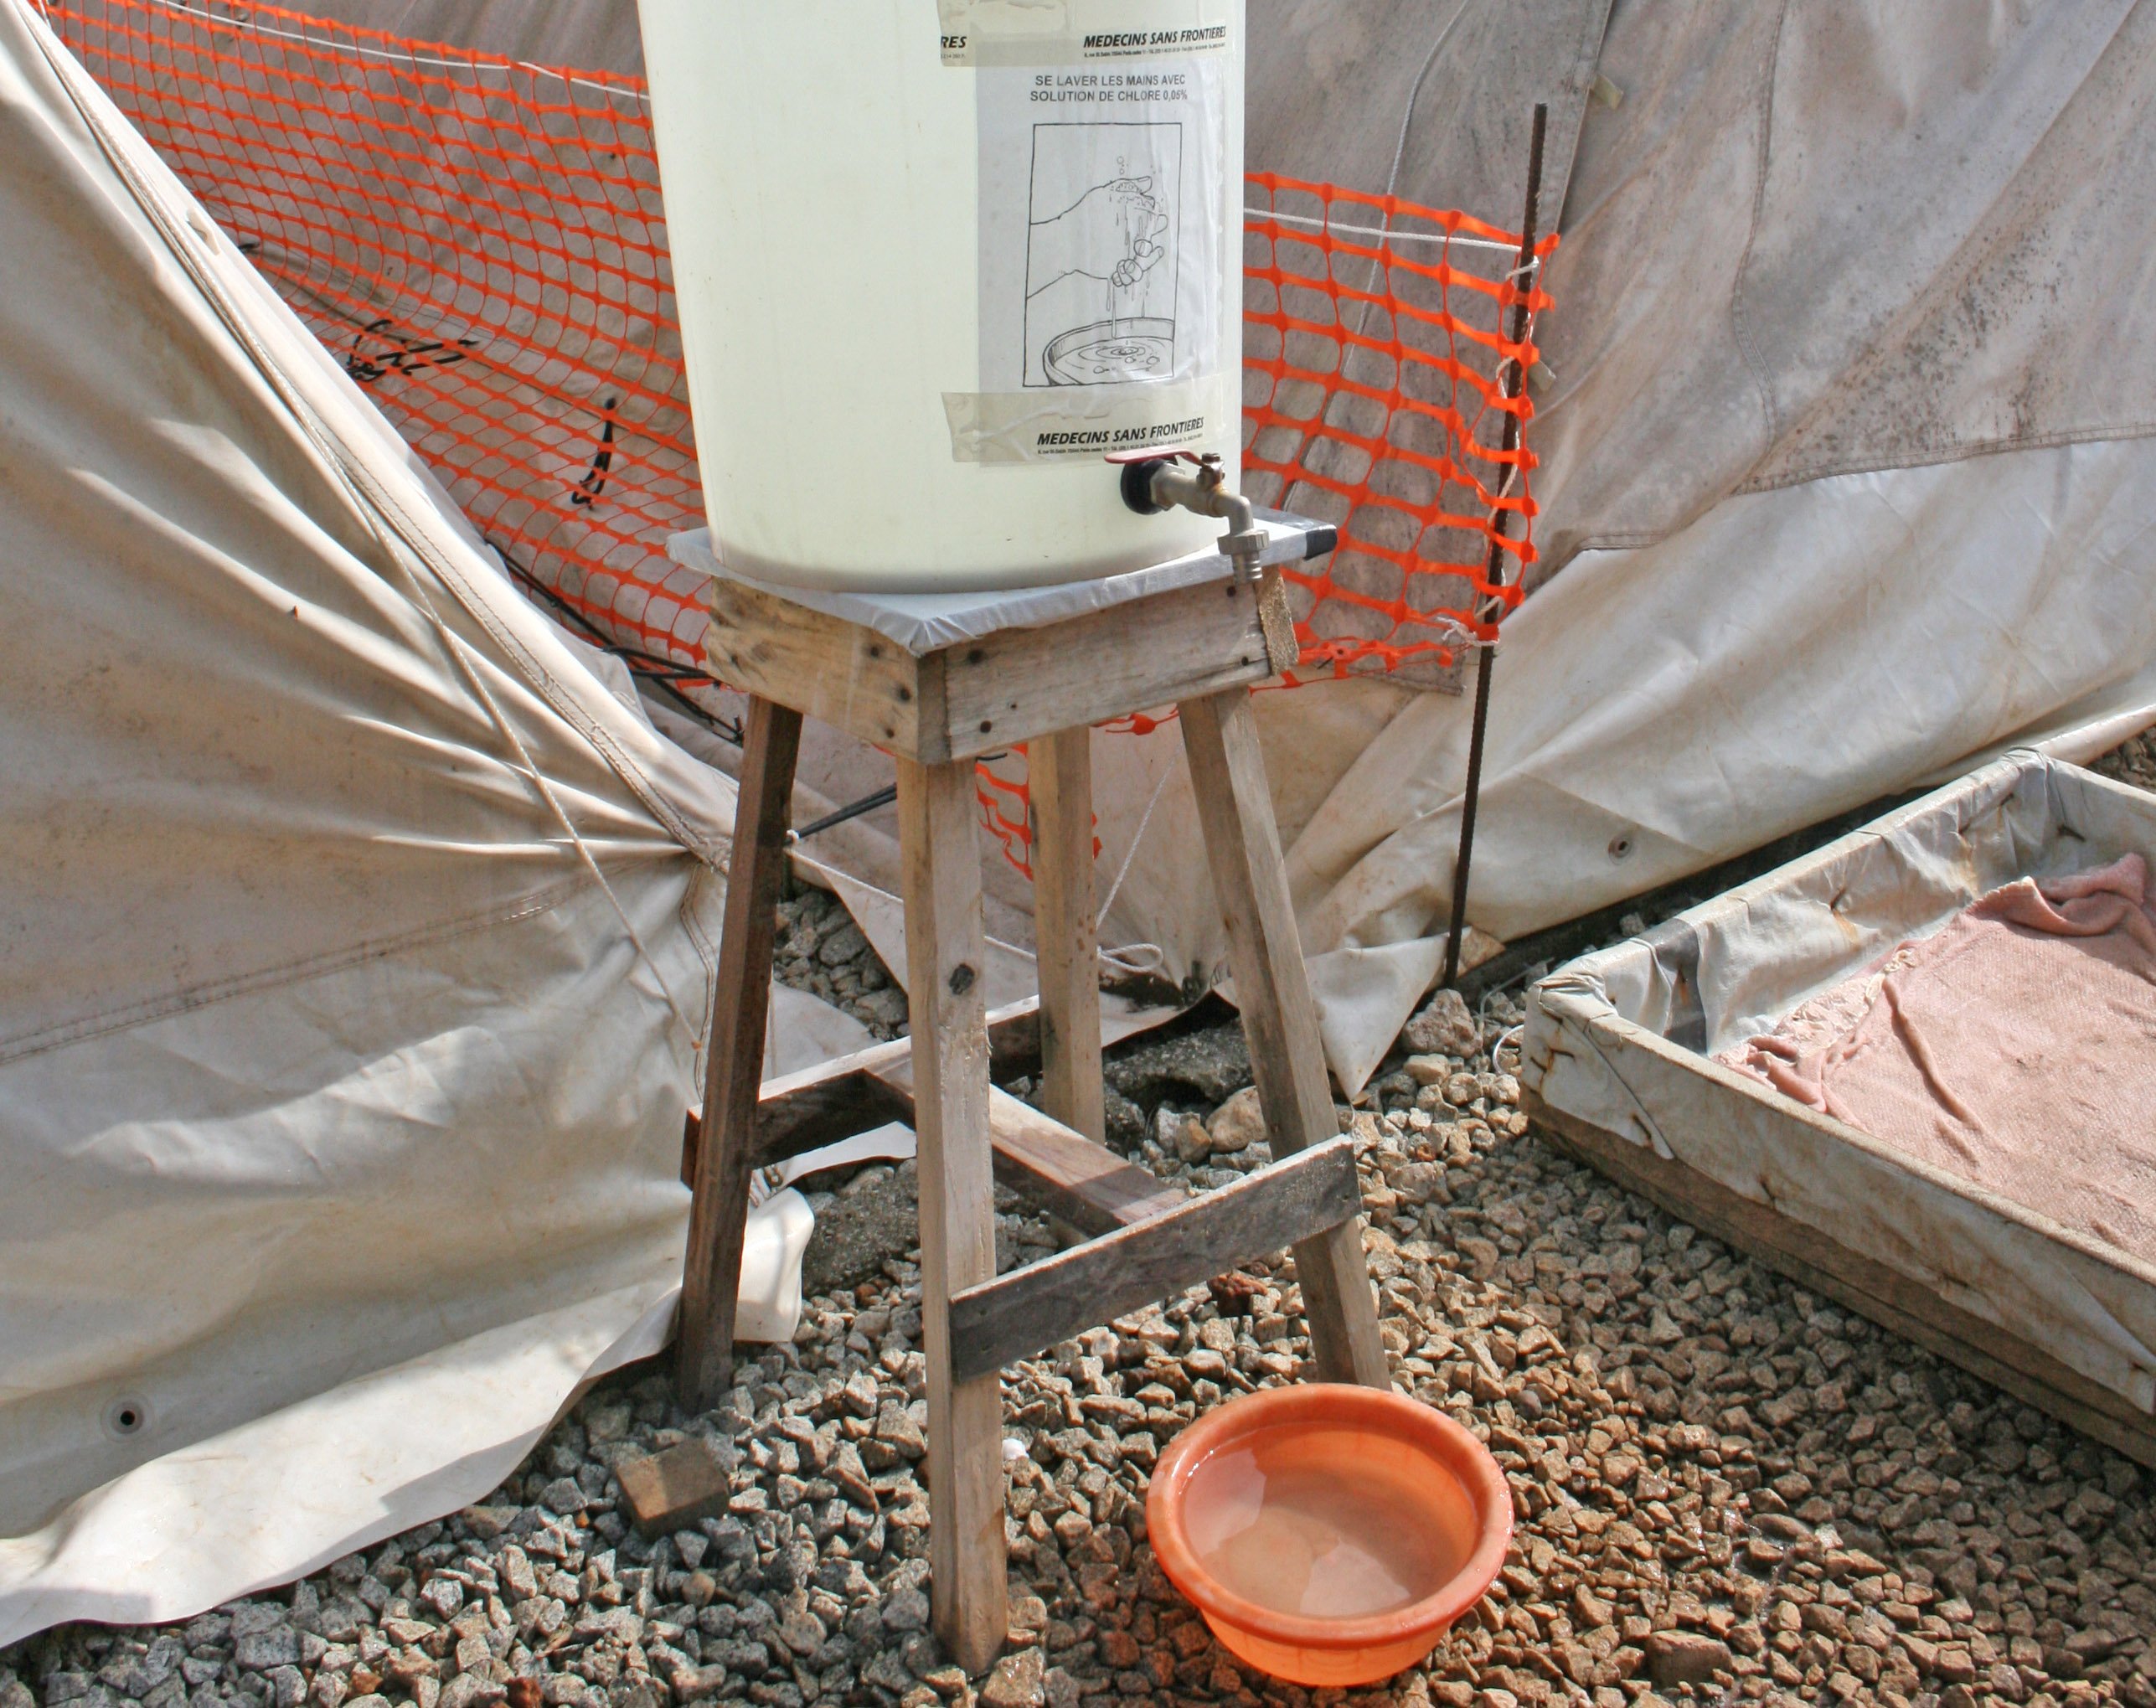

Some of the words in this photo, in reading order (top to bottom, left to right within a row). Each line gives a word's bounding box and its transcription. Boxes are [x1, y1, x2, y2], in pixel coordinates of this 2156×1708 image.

[1083, 33, 1148, 49] MEDECINS
[1149, 31, 1178, 44] SANS
[1180, 26, 1226, 42] FRONTIERES
[1035, 75, 1052, 86] SE
[1057, 75, 1097, 86] LAVER
[1101, 75, 1123, 86] LES
[1127, 75, 1158, 85] MAINS
[1162, 75, 1185, 85] AVEC
[1030, 90, 1095, 101] SOLUTION
[1099, 90, 1114, 101] DE
[1117, 90, 1161, 101] CHLORE
[1163, 89, 1188, 102] 0,05%
[1038, 431, 1108, 446] MEDECINS
[1112, 428, 1147, 442] SANS
[1150, 417, 1204, 438] FRONTIERES
